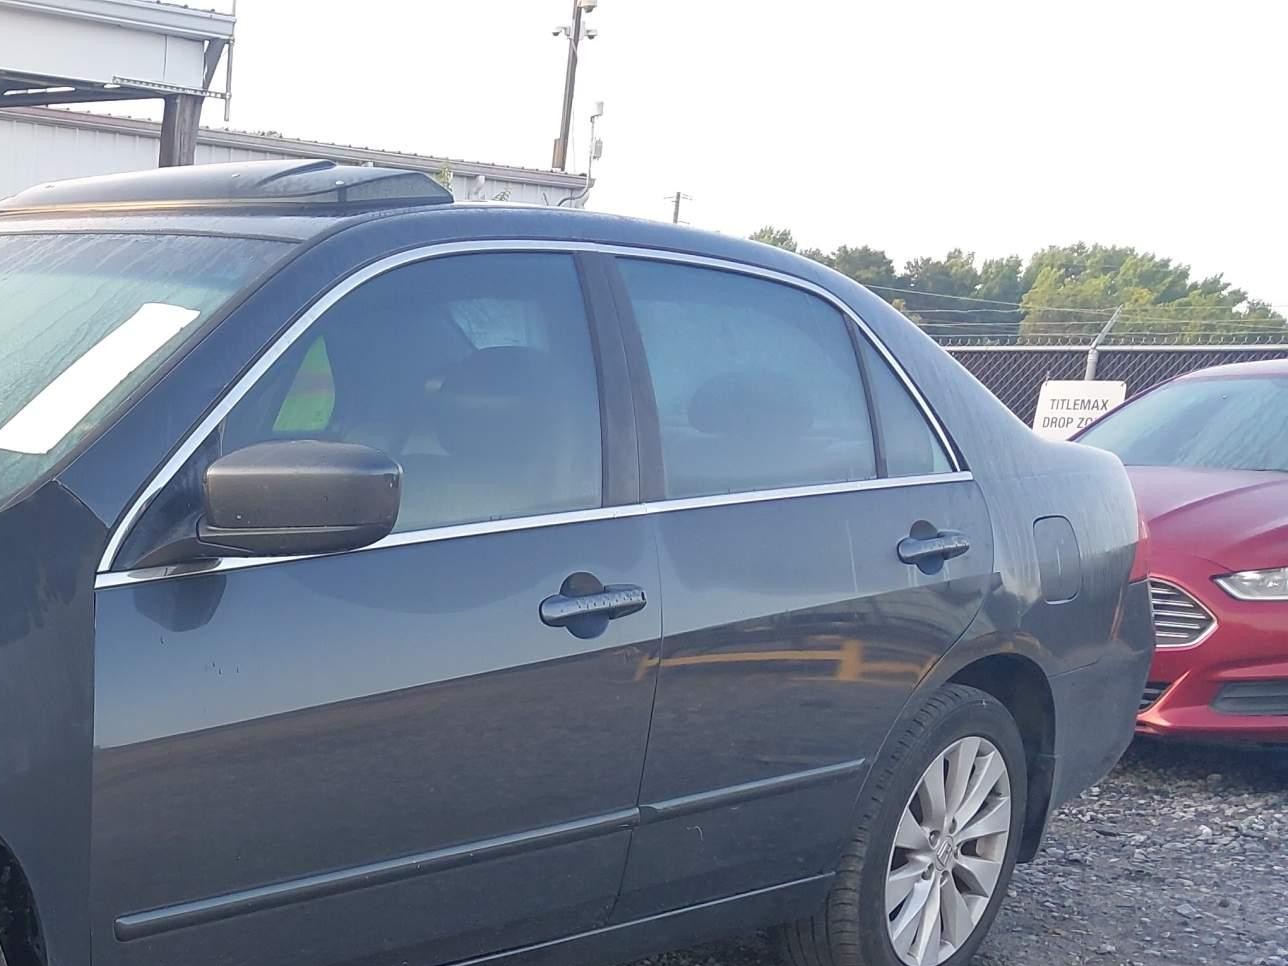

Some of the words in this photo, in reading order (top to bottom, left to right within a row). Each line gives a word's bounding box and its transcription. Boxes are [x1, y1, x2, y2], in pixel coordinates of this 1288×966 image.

[1049, 398, 1109, 410] TITLEMAX
[1042, 416, 1073, 428] DROP
[1077, 416, 1093, 428] ZO
